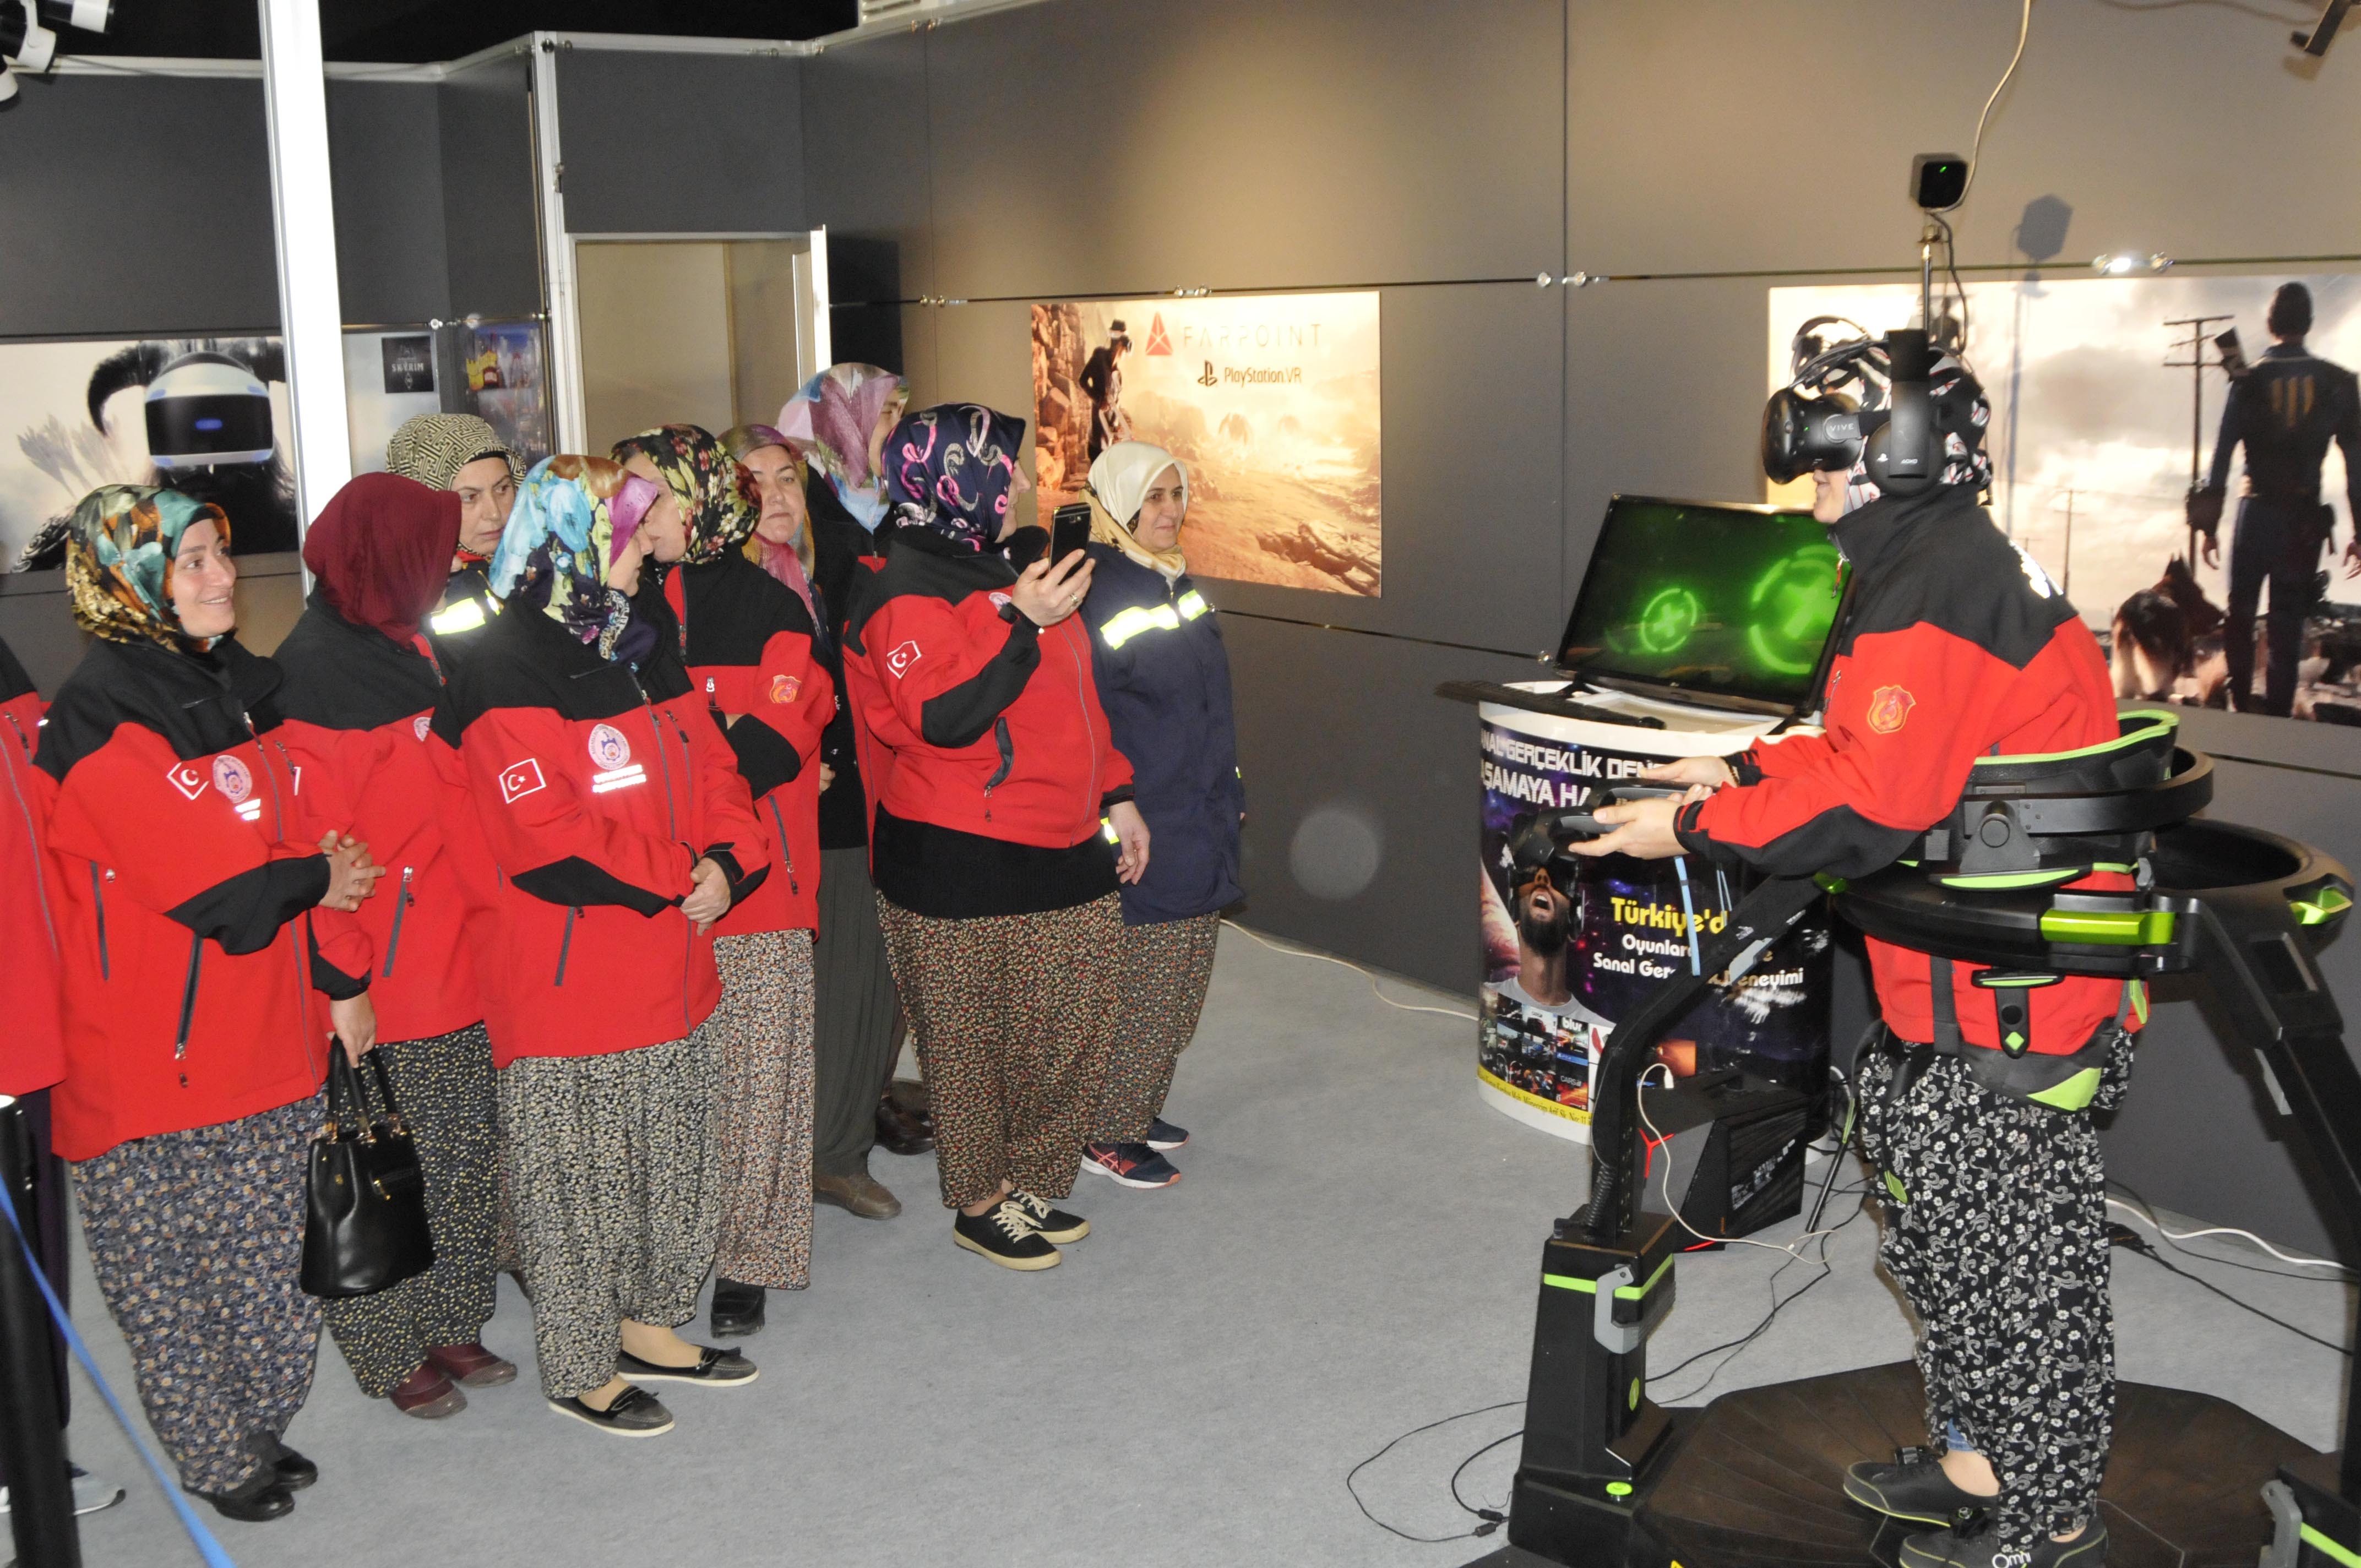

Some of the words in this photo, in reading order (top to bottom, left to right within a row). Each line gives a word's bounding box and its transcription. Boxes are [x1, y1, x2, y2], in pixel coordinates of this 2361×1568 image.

[1184, 324, 1320, 347] FARPOINT
[391, 362, 424, 372] SKYRIM
[1830, 423, 1854, 431] VIVE
[1506, 739, 1603, 778] GERÇEKLİK
[1593, 952, 1635, 974] Sanal
[1639, 960, 1677, 979] Ger
[1562, 1016, 1582, 1032] blur
[1560, 1075, 1576, 1086] CARS
[1992, 1552, 2032, 1568] Omni
